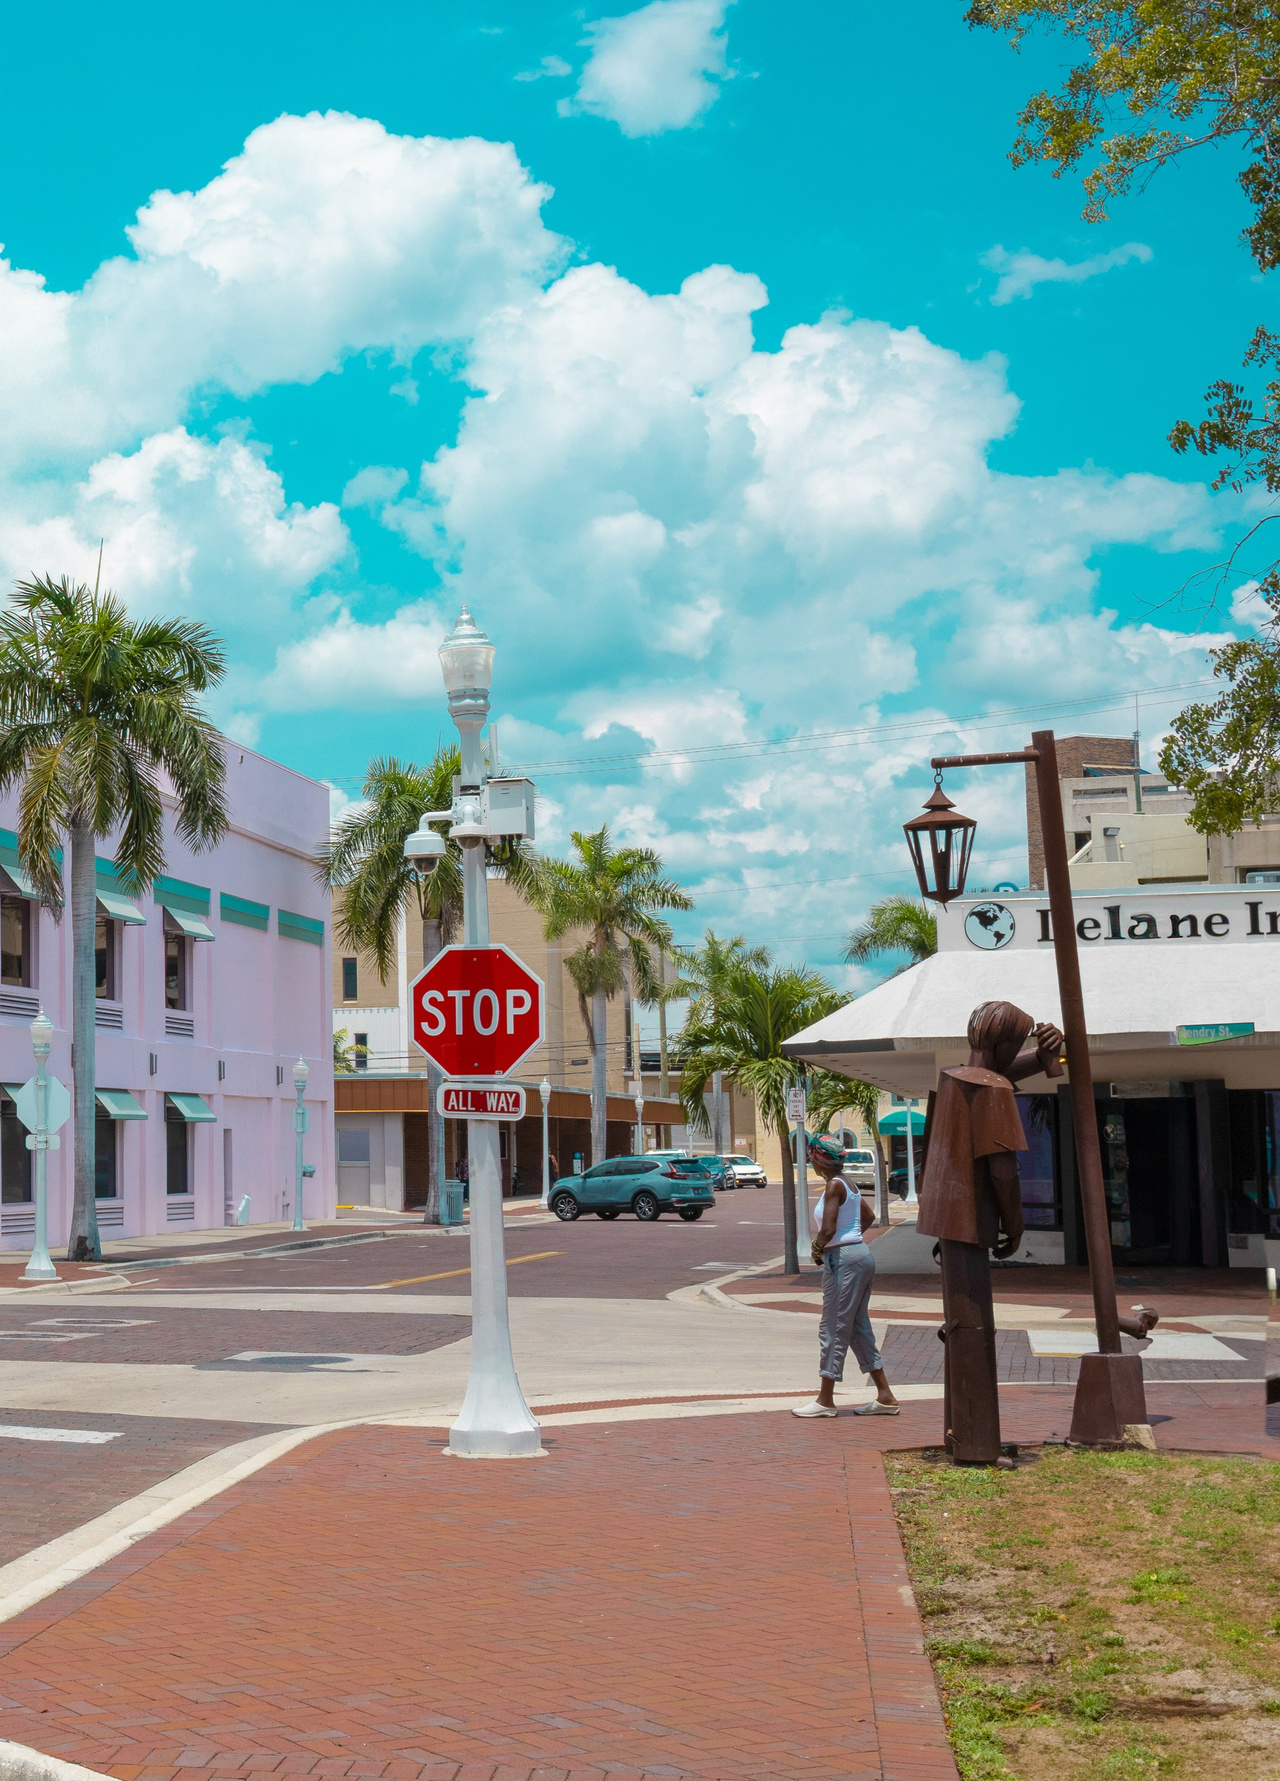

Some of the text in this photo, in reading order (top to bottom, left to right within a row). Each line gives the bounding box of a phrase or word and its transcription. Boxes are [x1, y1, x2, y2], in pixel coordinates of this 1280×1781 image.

[421, 989, 532, 1036] STOP
[447, 1091, 517, 1112] ALL WAY
